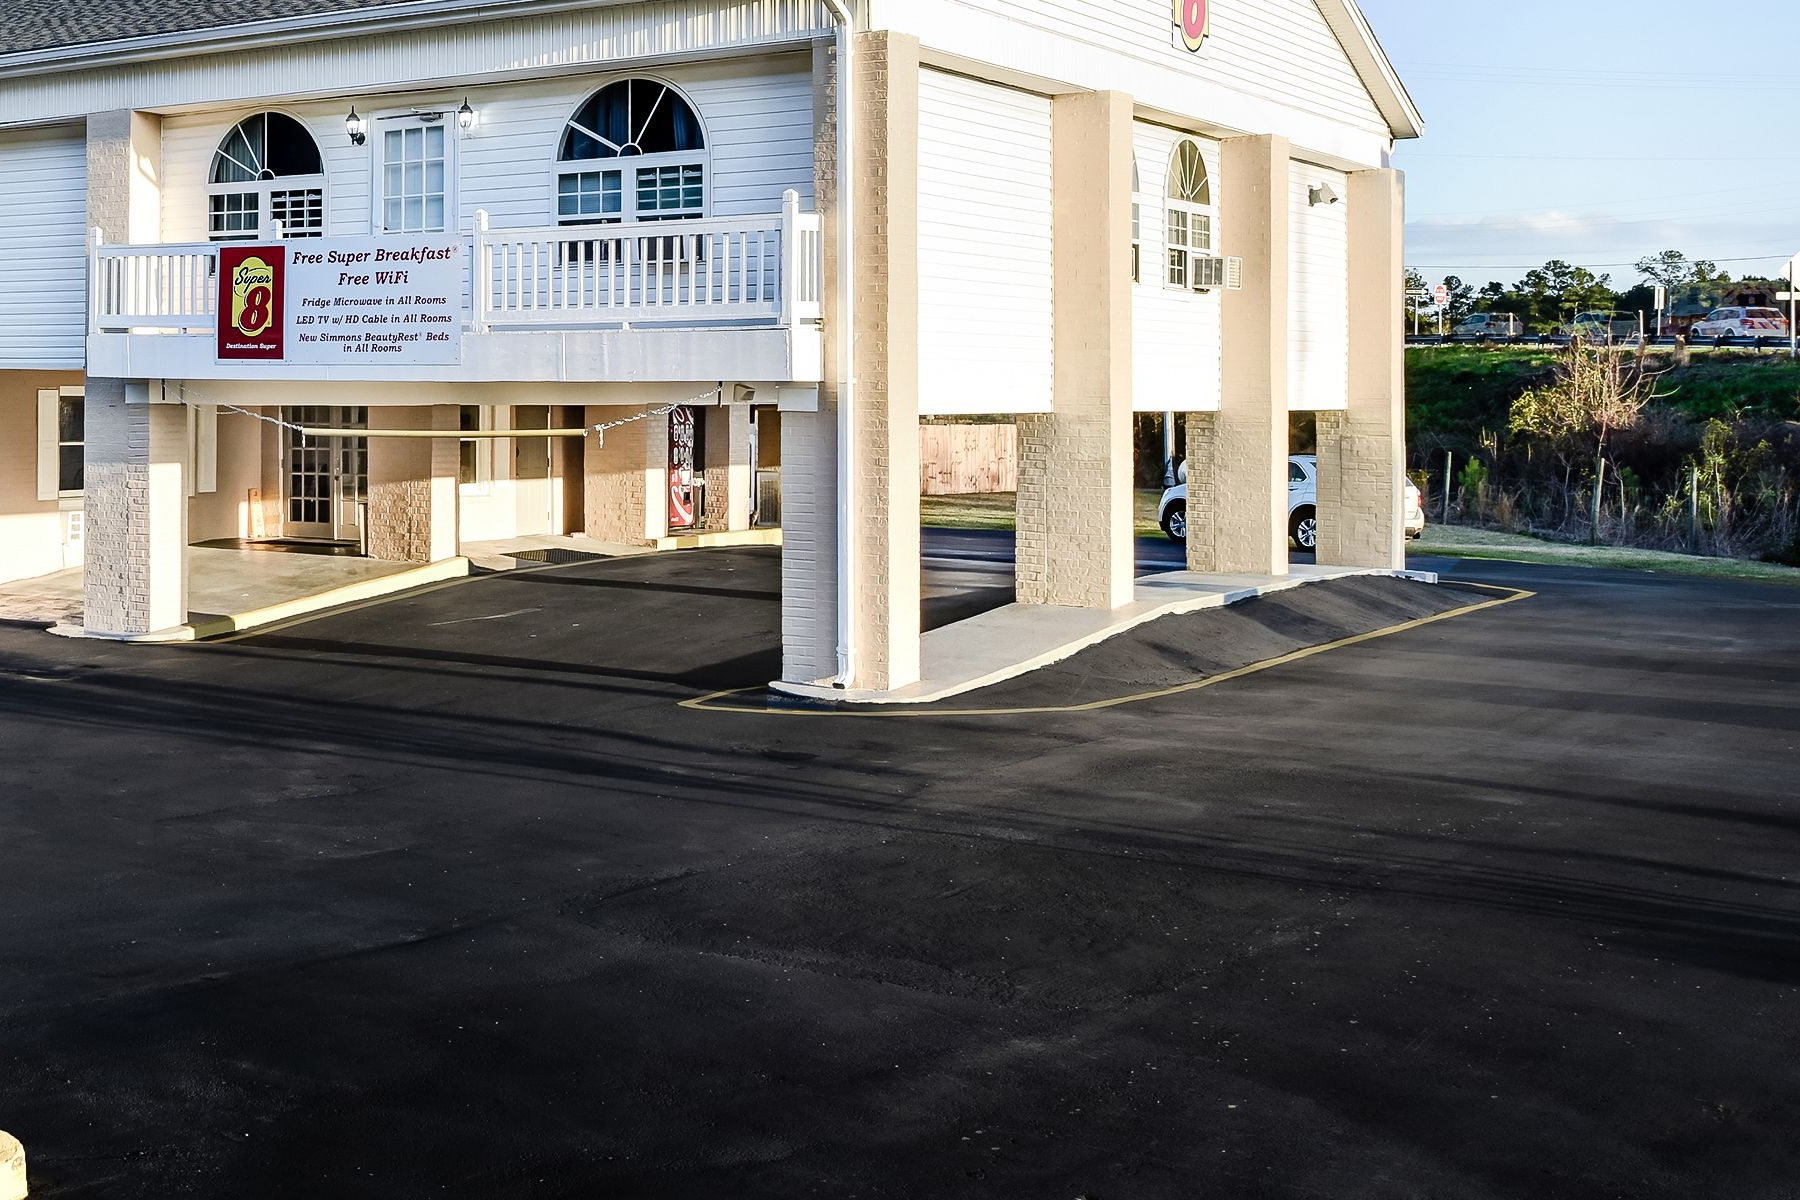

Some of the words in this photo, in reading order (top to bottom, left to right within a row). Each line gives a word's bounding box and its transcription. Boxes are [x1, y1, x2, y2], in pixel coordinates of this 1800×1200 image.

[292, 252, 323, 264] Free
[327, 251, 371, 266] Super
[375, 246, 451, 264] Breakfast
[235, 267, 271, 293] Super
[338, 273, 370, 285] Free
[375, 271, 409, 285] WiFi
[301, 298, 331, 308] Fridge
[333, 297, 382, 306] Microwave
[385, 296, 395, 305] in
[397, 296, 412, 305] All
[414, 296, 447, 305] Rooms
[239, 286, 271, 332] 8
[296, 316, 315, 325] LED
[317, 315, 330, 324] TV
[331, 315, 344, 325] w/
[345, 315, 359, 324] HD
[361, 315, 388, 324] Cable
[390, 314, 400, 323] in
[403, 314, 417, 323] All
[419, 314, 452, 323] Rooms
[298, 333, 317, 342] New
[320, 333, 362, 342] Simmons
[425, 332, 450, 341] Beds
[259, 342, 277, 350] Super
[343, 344, 352, 353] in
[354, 343, 369, 352] All
[371, 344, 402, 352] Rooms
